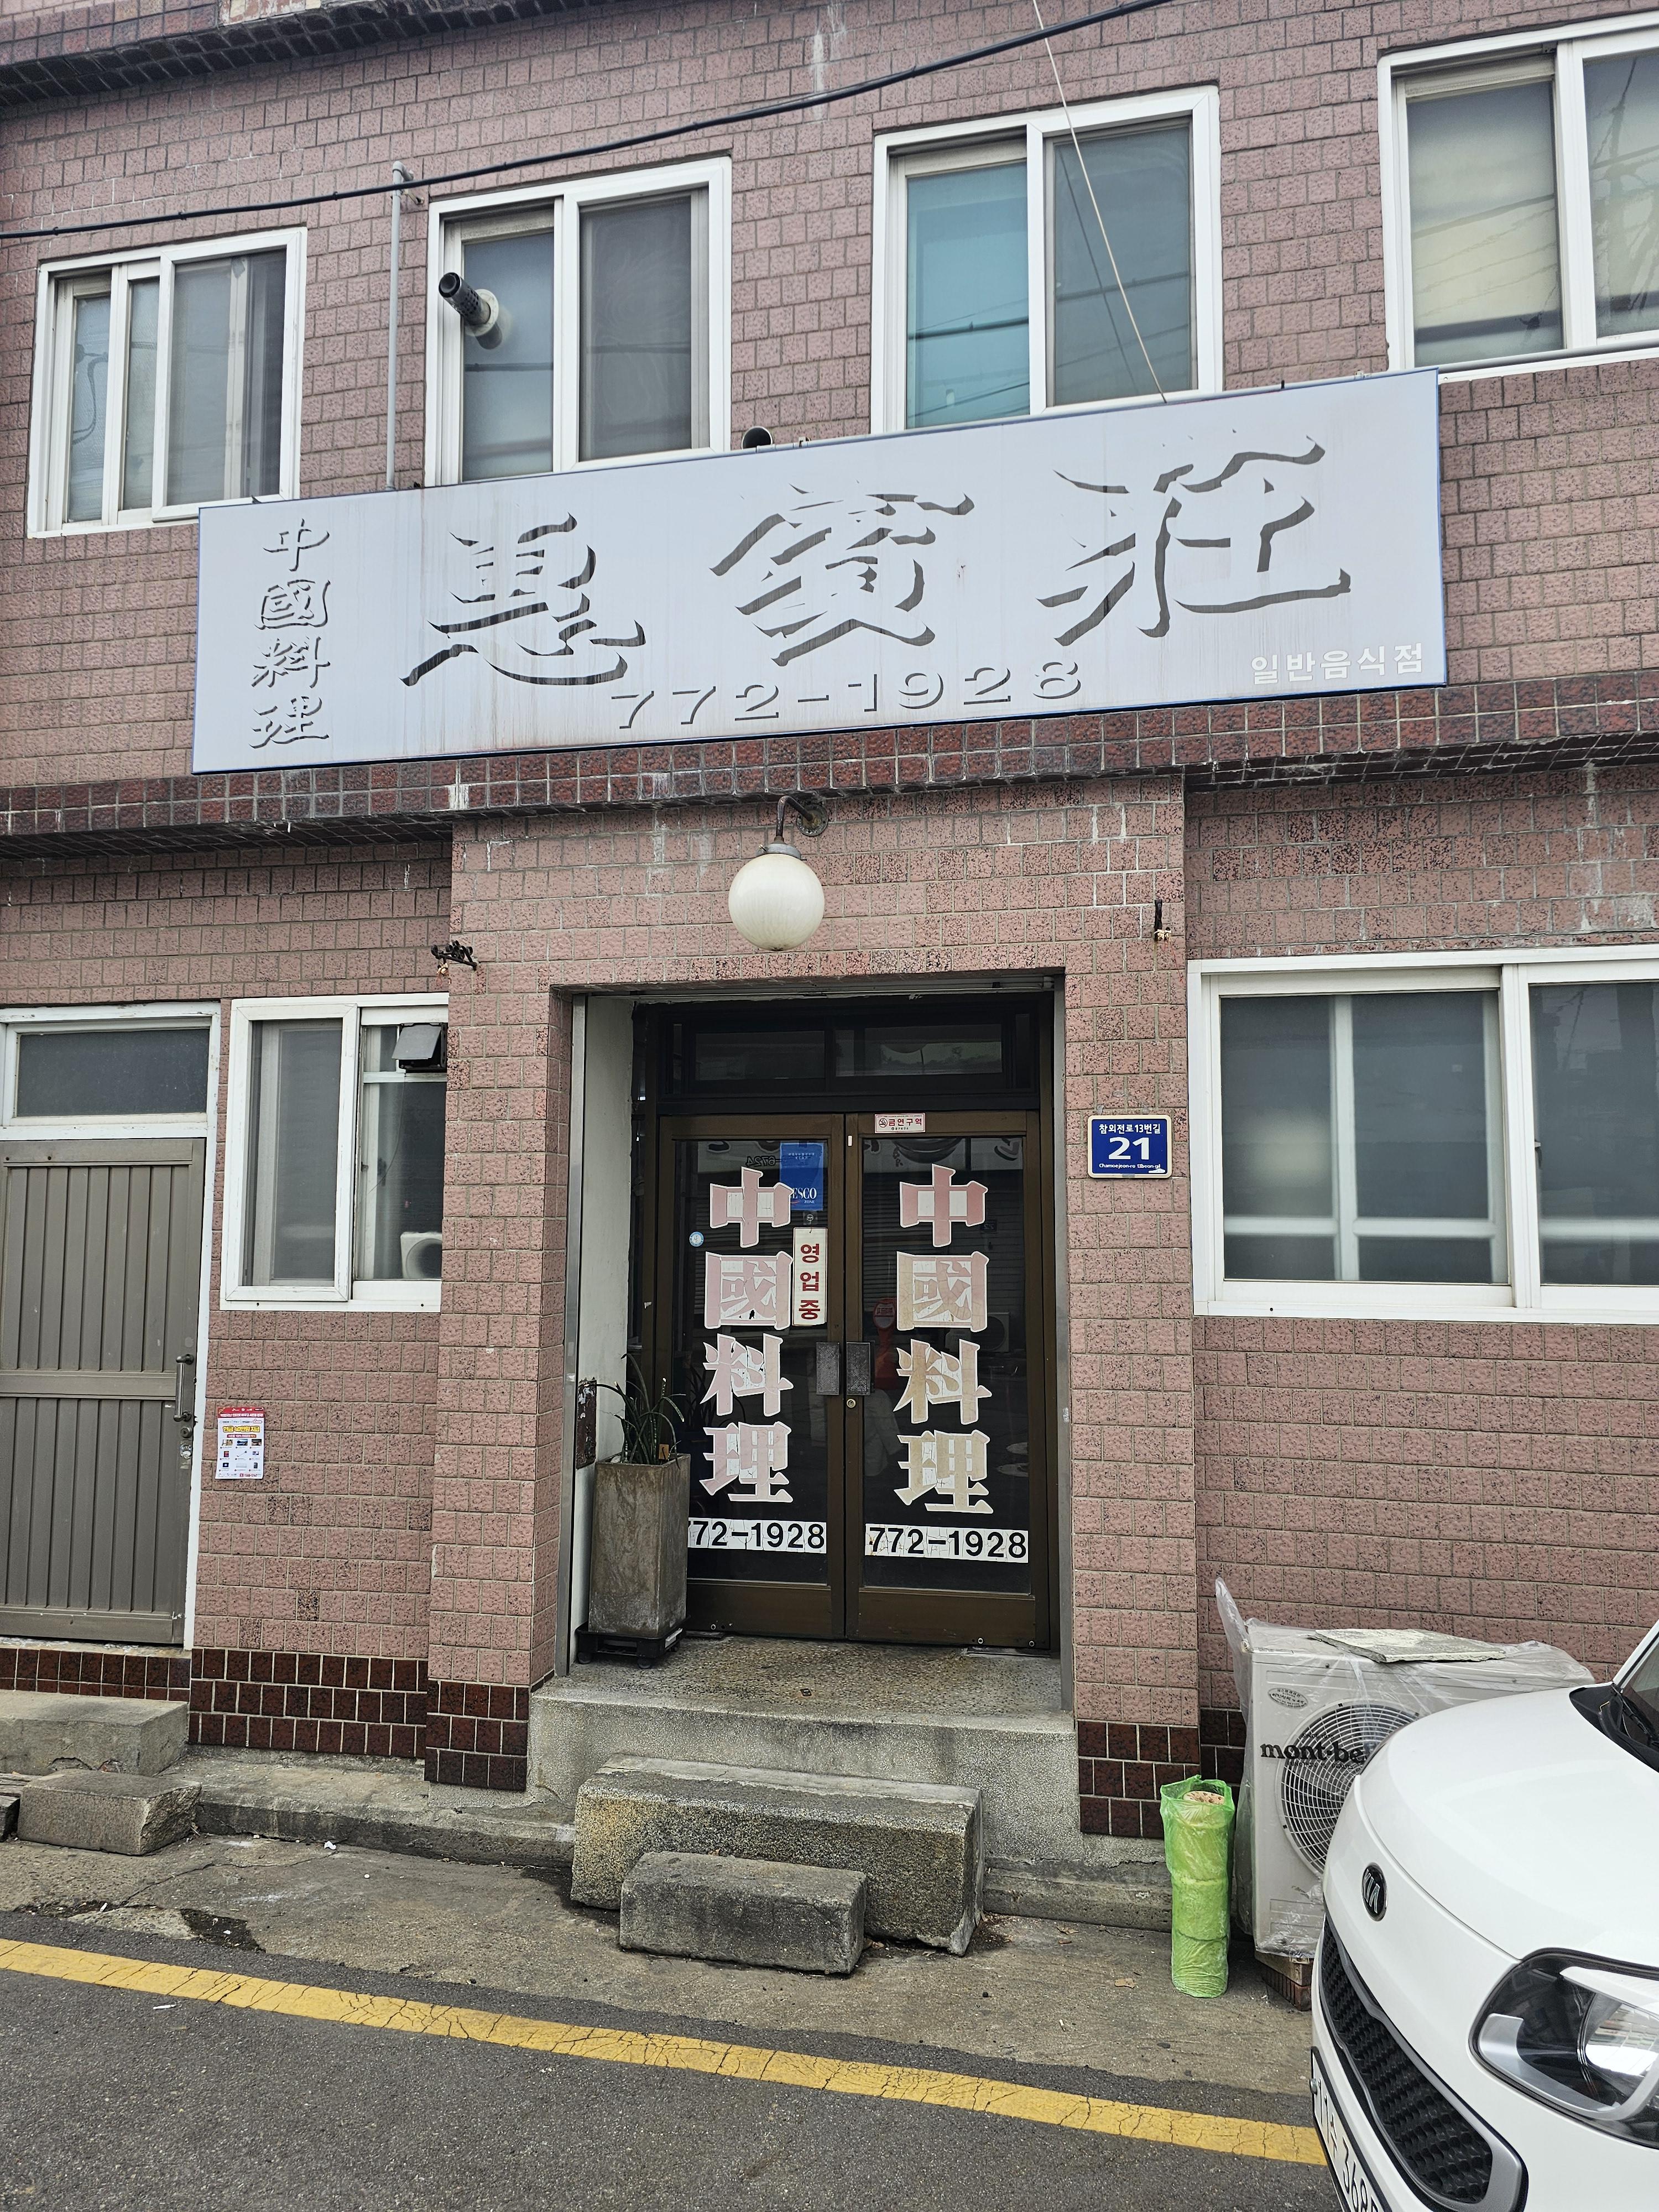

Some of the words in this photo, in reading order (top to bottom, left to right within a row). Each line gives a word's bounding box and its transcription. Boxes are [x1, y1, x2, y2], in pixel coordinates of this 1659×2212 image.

[251, 519, 331, 748] 中國料理
[1251, 643, 1422, 685] 일반음식점
[612, 661, 1082, 729] 772-1928
[888, 1118, 922, 1126] 금연구역
[1099, 1124, 1161, 1134] 참외전로13번길
[1108, 1137, 1149, 1160] 21
[791, 1187, 817, 1199] ESCO
[799, 1243, 820, 1319] 영업중
[700, 1166, 794, 1503] 中國料理
[893, 1164, 994, 1514] 中國料理
[688, 1520, 825, 1549] 72-1928
[870, 1526, 1025, 1559] 772-1928
[1362, 1869, 1381, 1914] KIA
